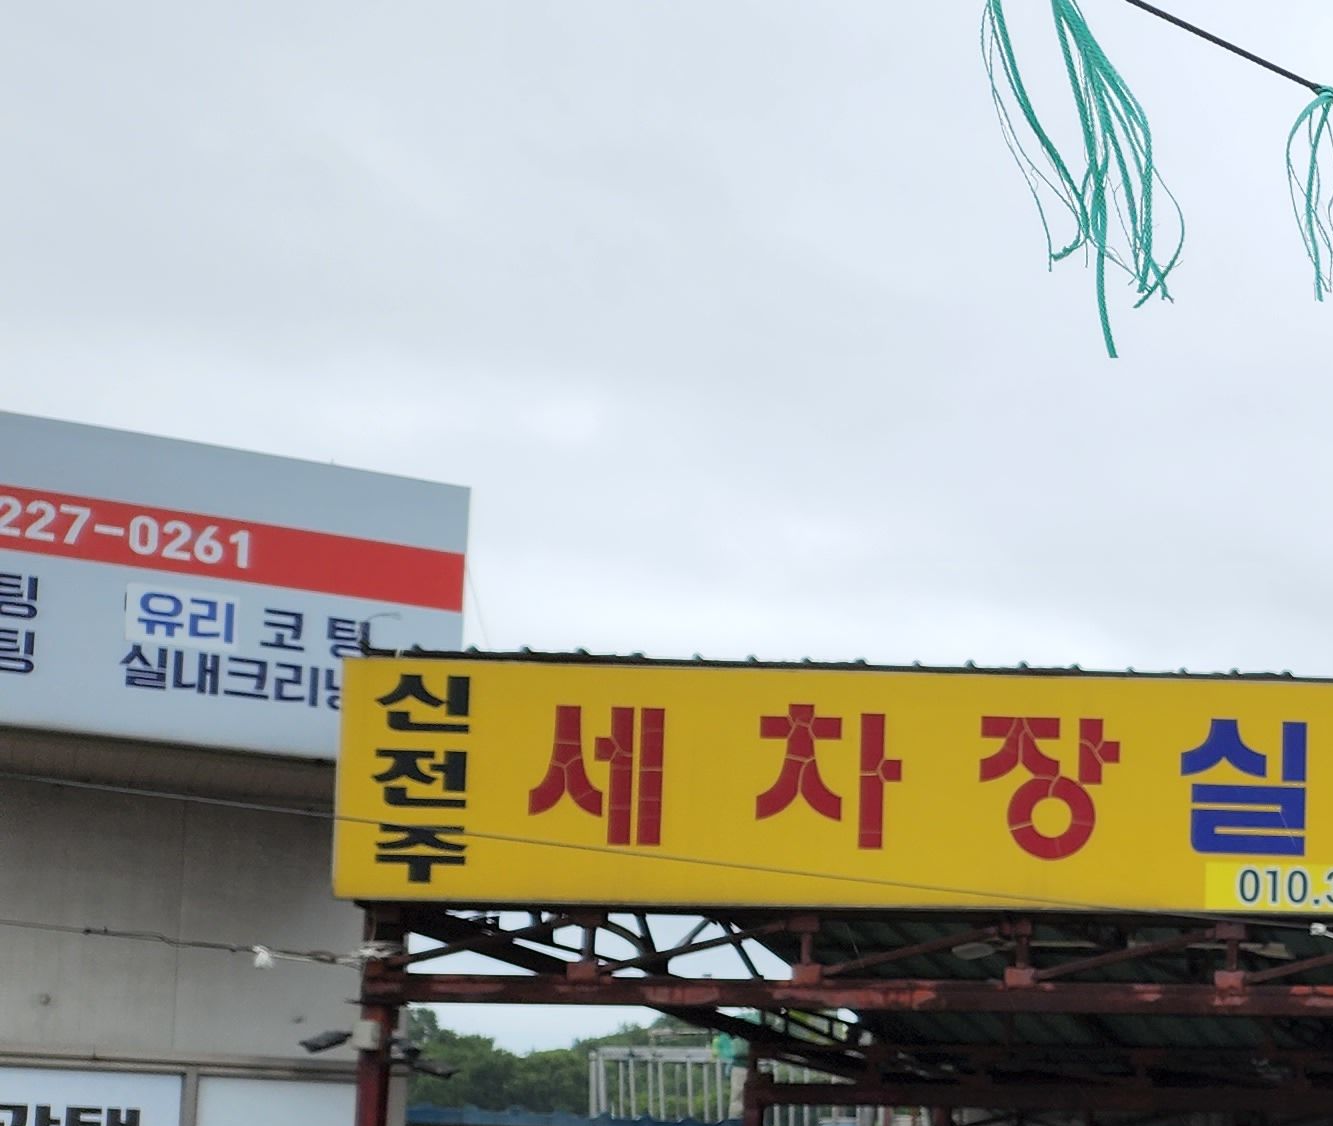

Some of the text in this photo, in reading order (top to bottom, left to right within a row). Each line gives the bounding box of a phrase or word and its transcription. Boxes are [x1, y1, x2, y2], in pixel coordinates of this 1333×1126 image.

[0, 495, 250, 569] 227-0261
[137, 592, 235, 644] 유리
[372, 673, 471, 884] 신전주
